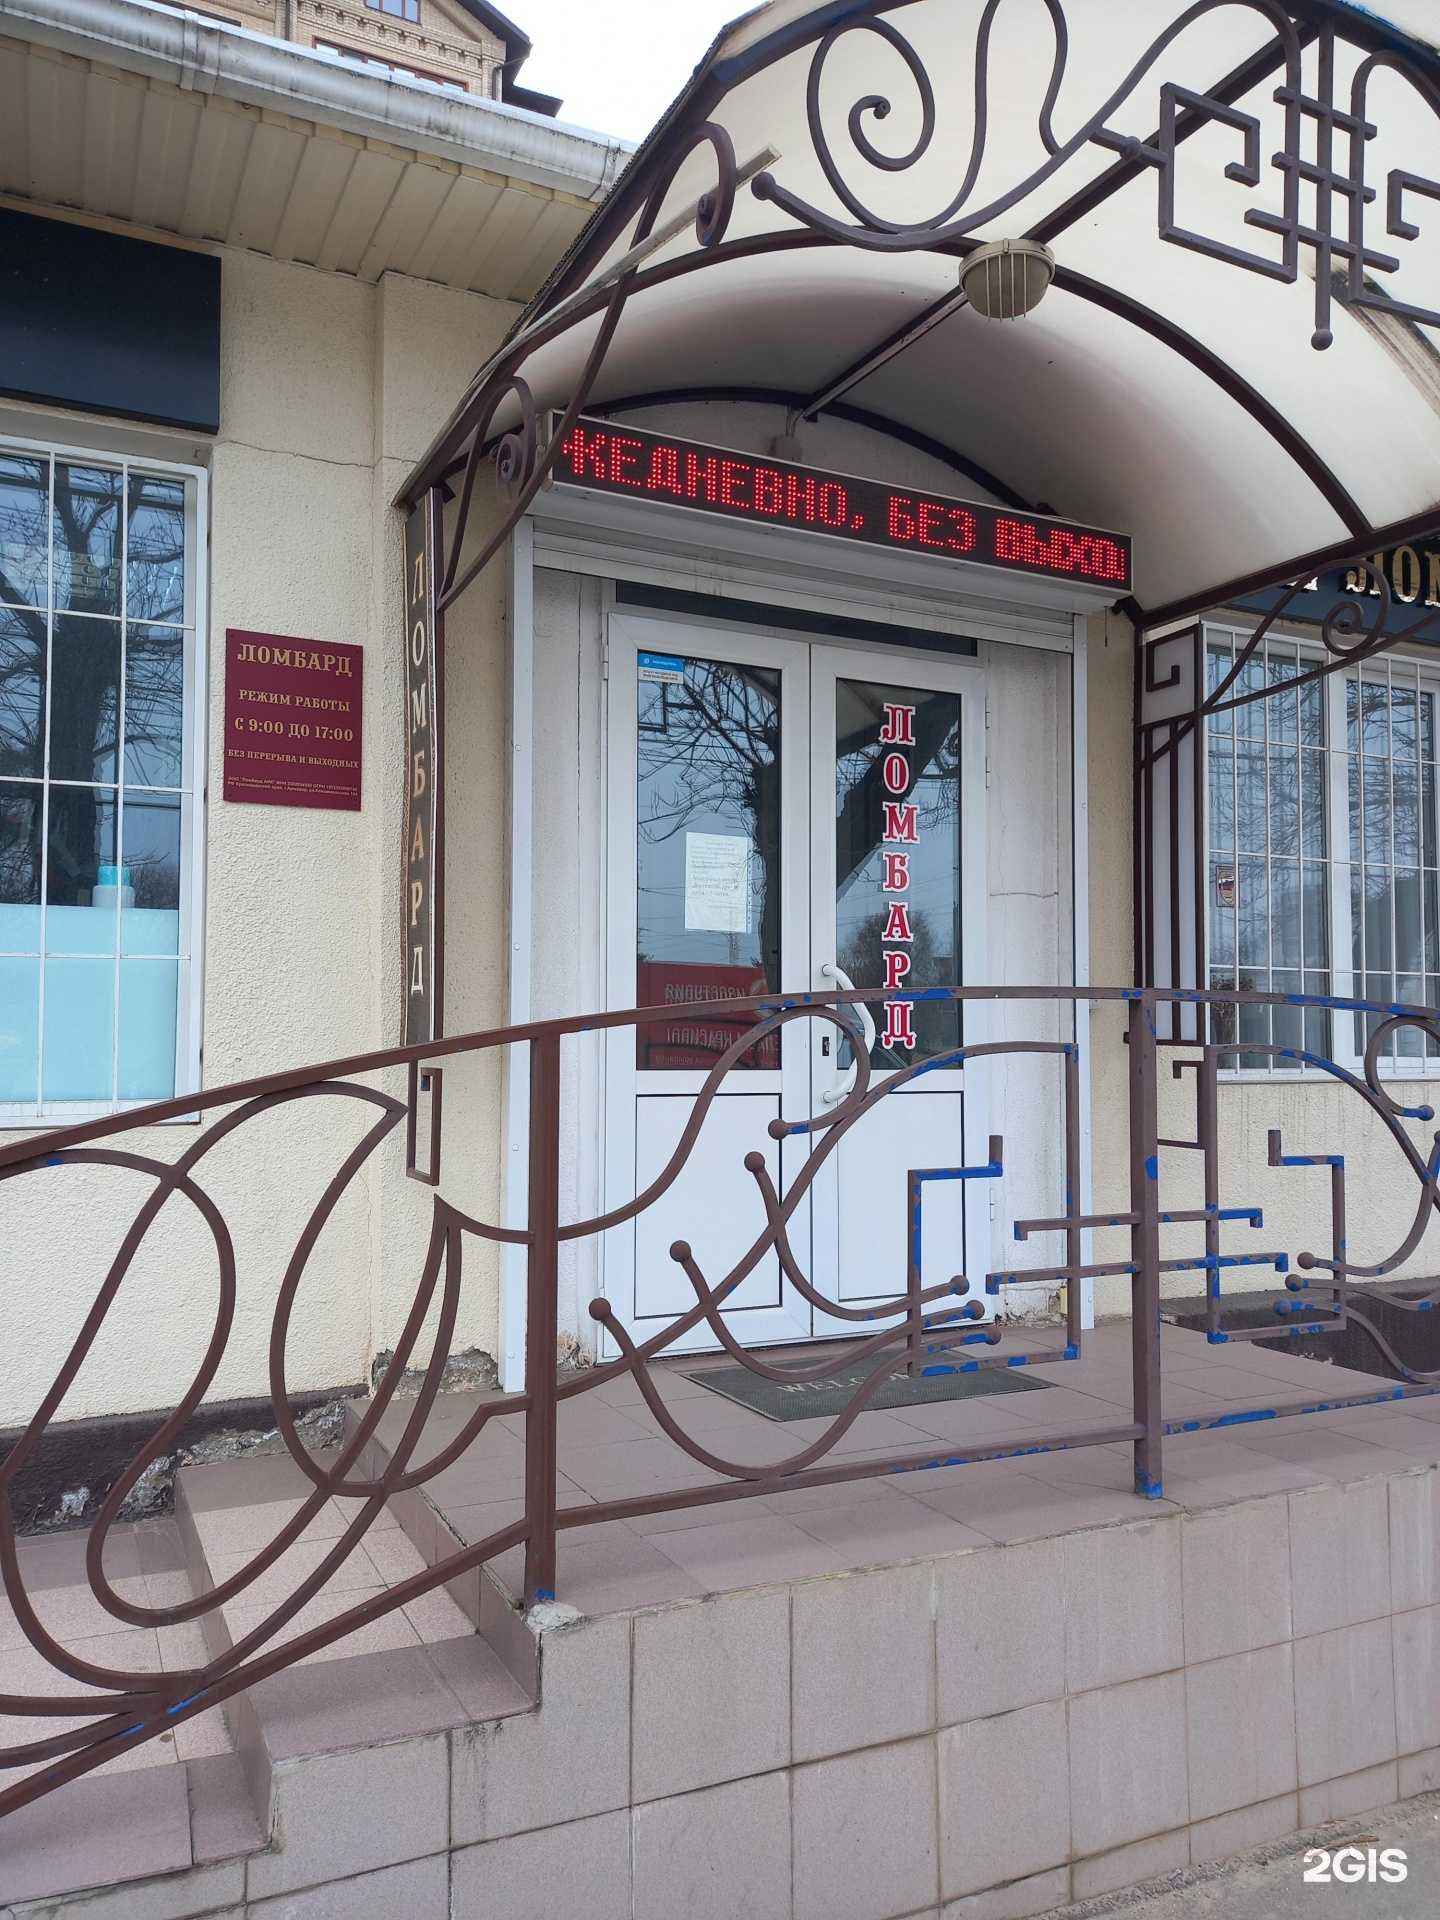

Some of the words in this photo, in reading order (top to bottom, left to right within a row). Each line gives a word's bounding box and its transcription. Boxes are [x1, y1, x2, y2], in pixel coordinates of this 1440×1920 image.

[889, 495, 977, 552] БЕЗ
[237, 642, 353, 678] ЛОМБАРД
[239, 689, 292, 706] РЕЖИМ
[295, 695, 351, 712] РАБОТЫ
[234, 717, 244, 730] С
[249, 718, 284, 735] 9:00
[288, 723, 310, 739] ДО
[315, 725, 354, 742] 17:00
[227, 749, 245, 759] БЕЗ
[247, 751, 297, 764] ПЕРЕРЫВА
[299, 755, 306, 764] И
[308, 756, 359, 769] ВЫХОДНЫХ
[411, 551, 428, 996] ЛОМБАРД
[878, 702, 920, 1050] ЛОМБАРД
